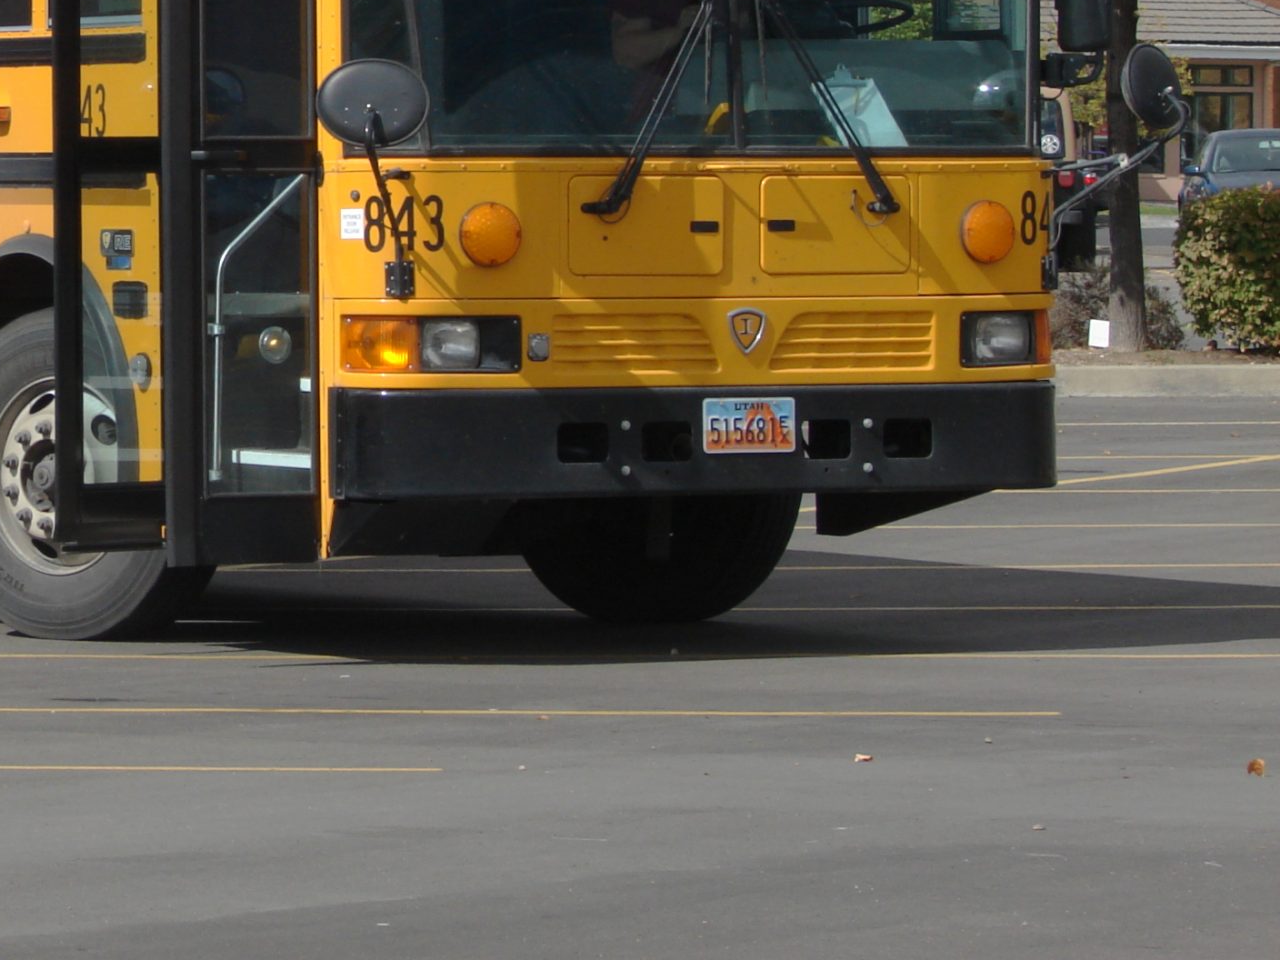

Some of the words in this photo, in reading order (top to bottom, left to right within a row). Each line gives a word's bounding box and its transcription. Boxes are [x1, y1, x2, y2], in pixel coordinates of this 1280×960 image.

[364, 194, 445, 253] 843
[734, 402, 765, 411] UTAH
[709, 416, 776, 444] 515681
